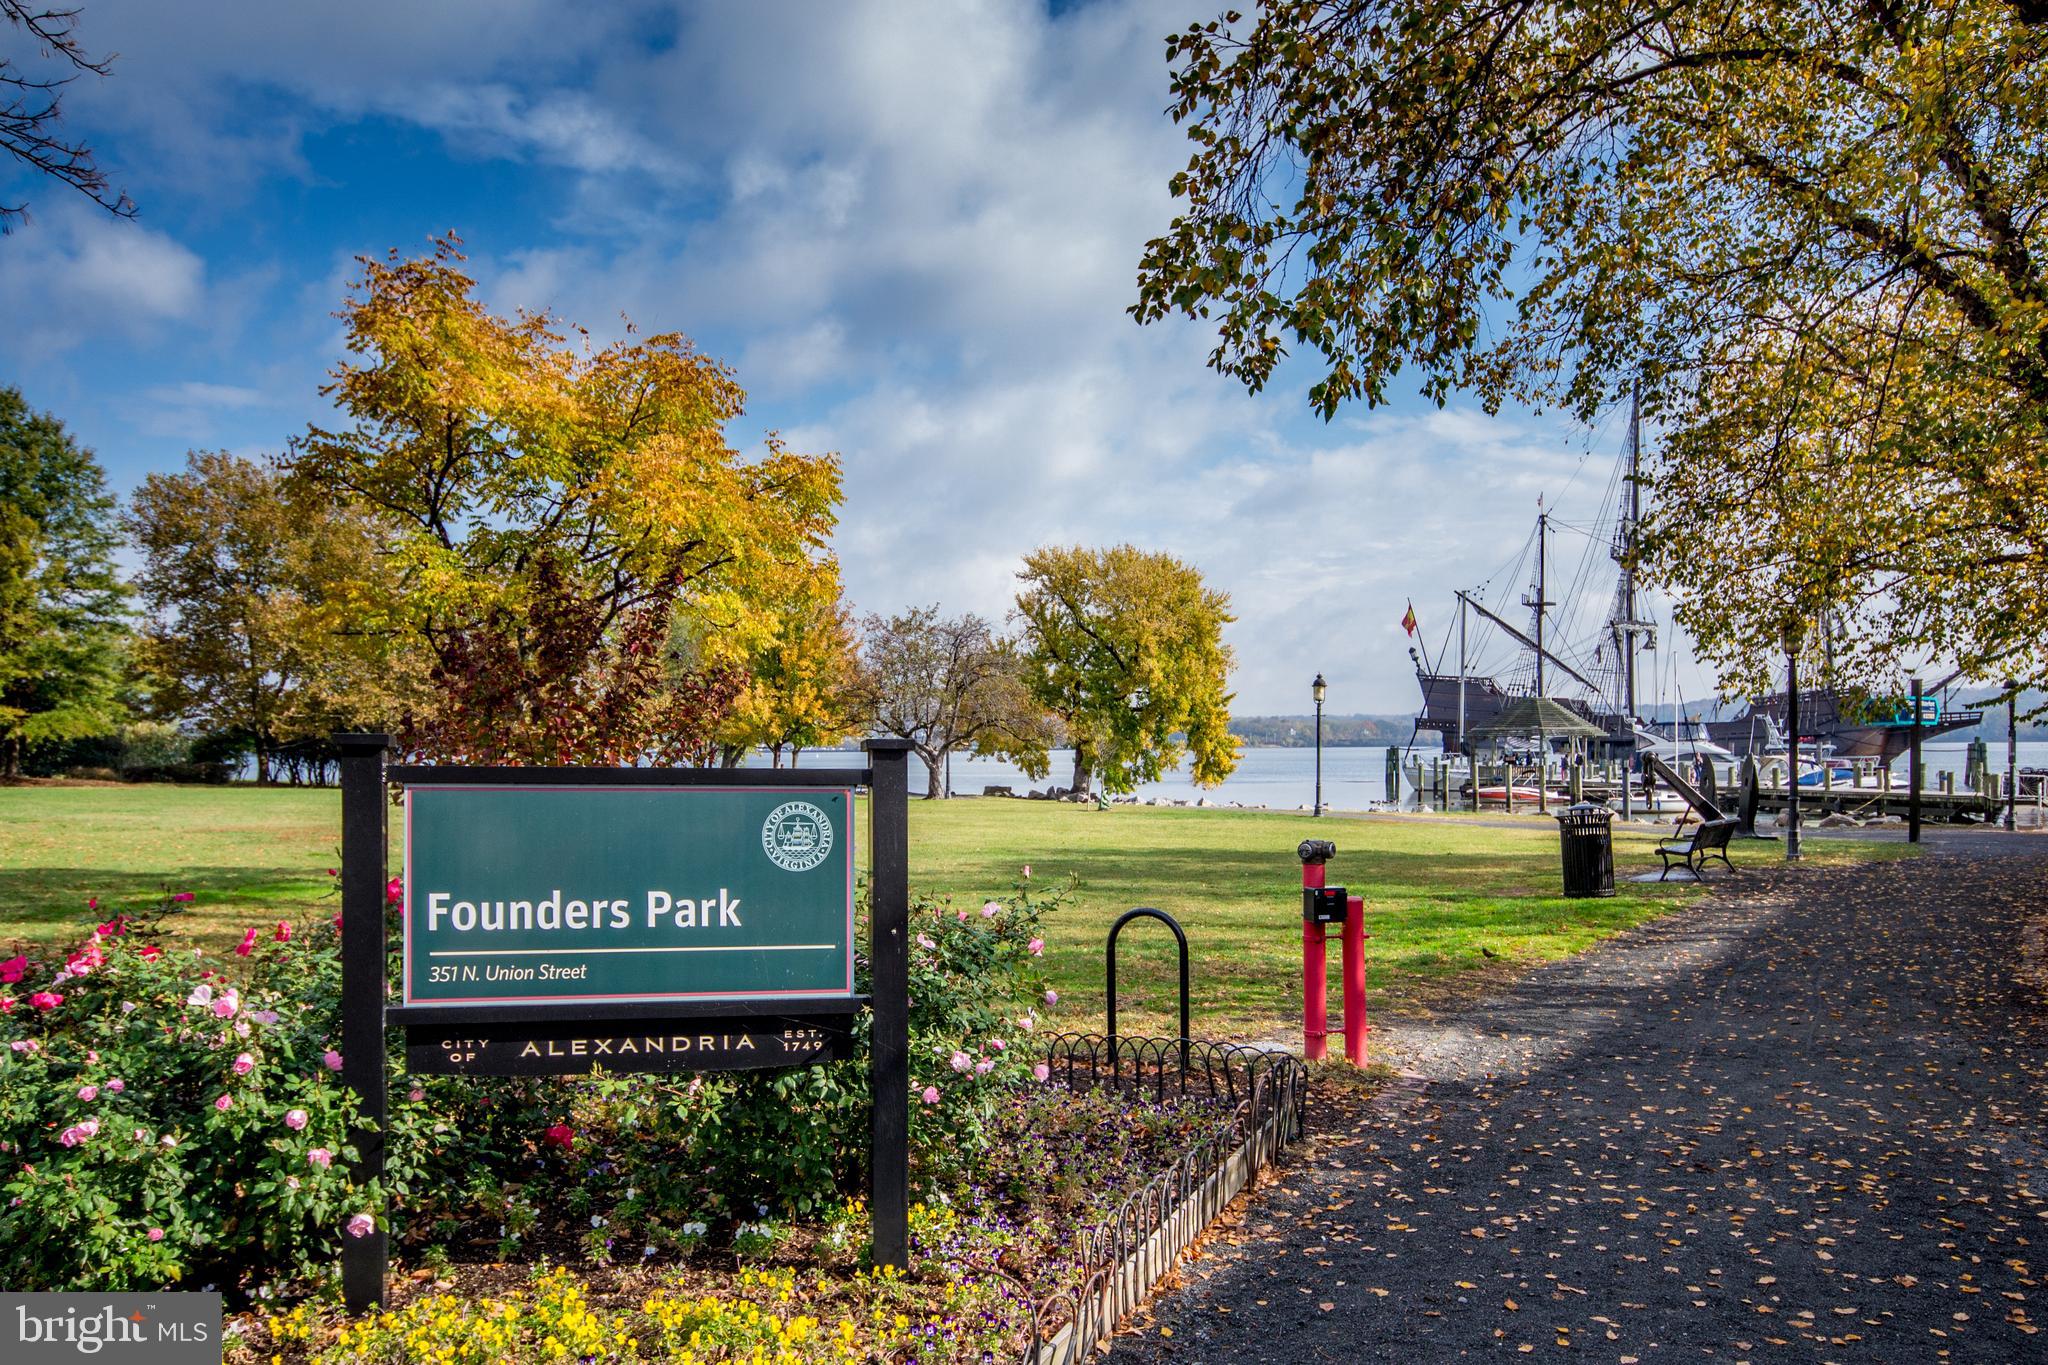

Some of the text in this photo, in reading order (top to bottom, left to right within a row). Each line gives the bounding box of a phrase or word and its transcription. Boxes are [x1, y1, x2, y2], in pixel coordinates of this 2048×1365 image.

[785, 804, 831, 847] ALEXANDRIA
[772, 851, 824, 869] VIRGINIA
[428, 888, 742, 931] Founders Park
[428, 964, 587, 982] 351 N. Union Street
[784, 1029, 823, 1039] EST.
[441, 1039, 489, 1049] CITY
[520, 1034, 755, 1057] ALEXANDRIA
[783, 1041, 823, 1052] 1749
[449, 1053, 476, 1063] OF
